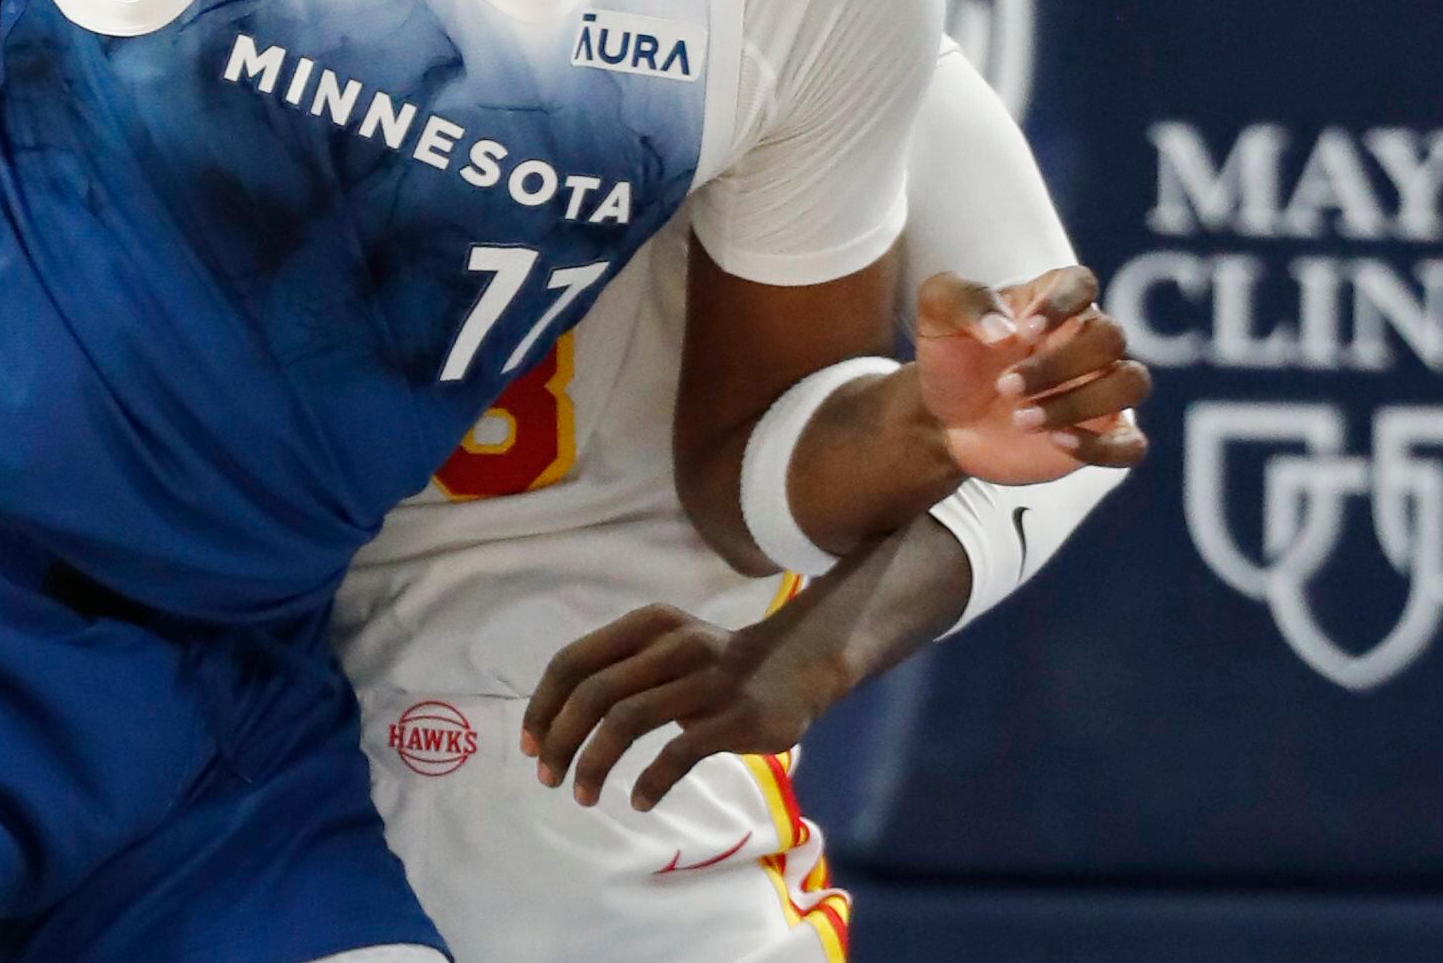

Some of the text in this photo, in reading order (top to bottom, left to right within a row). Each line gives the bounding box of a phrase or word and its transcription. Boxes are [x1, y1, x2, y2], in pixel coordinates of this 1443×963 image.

[223, 34, 632, 225] MINNESOTA
[439, 245, 612, 383] 11
[388, 723, 478, 755] HAWKS
